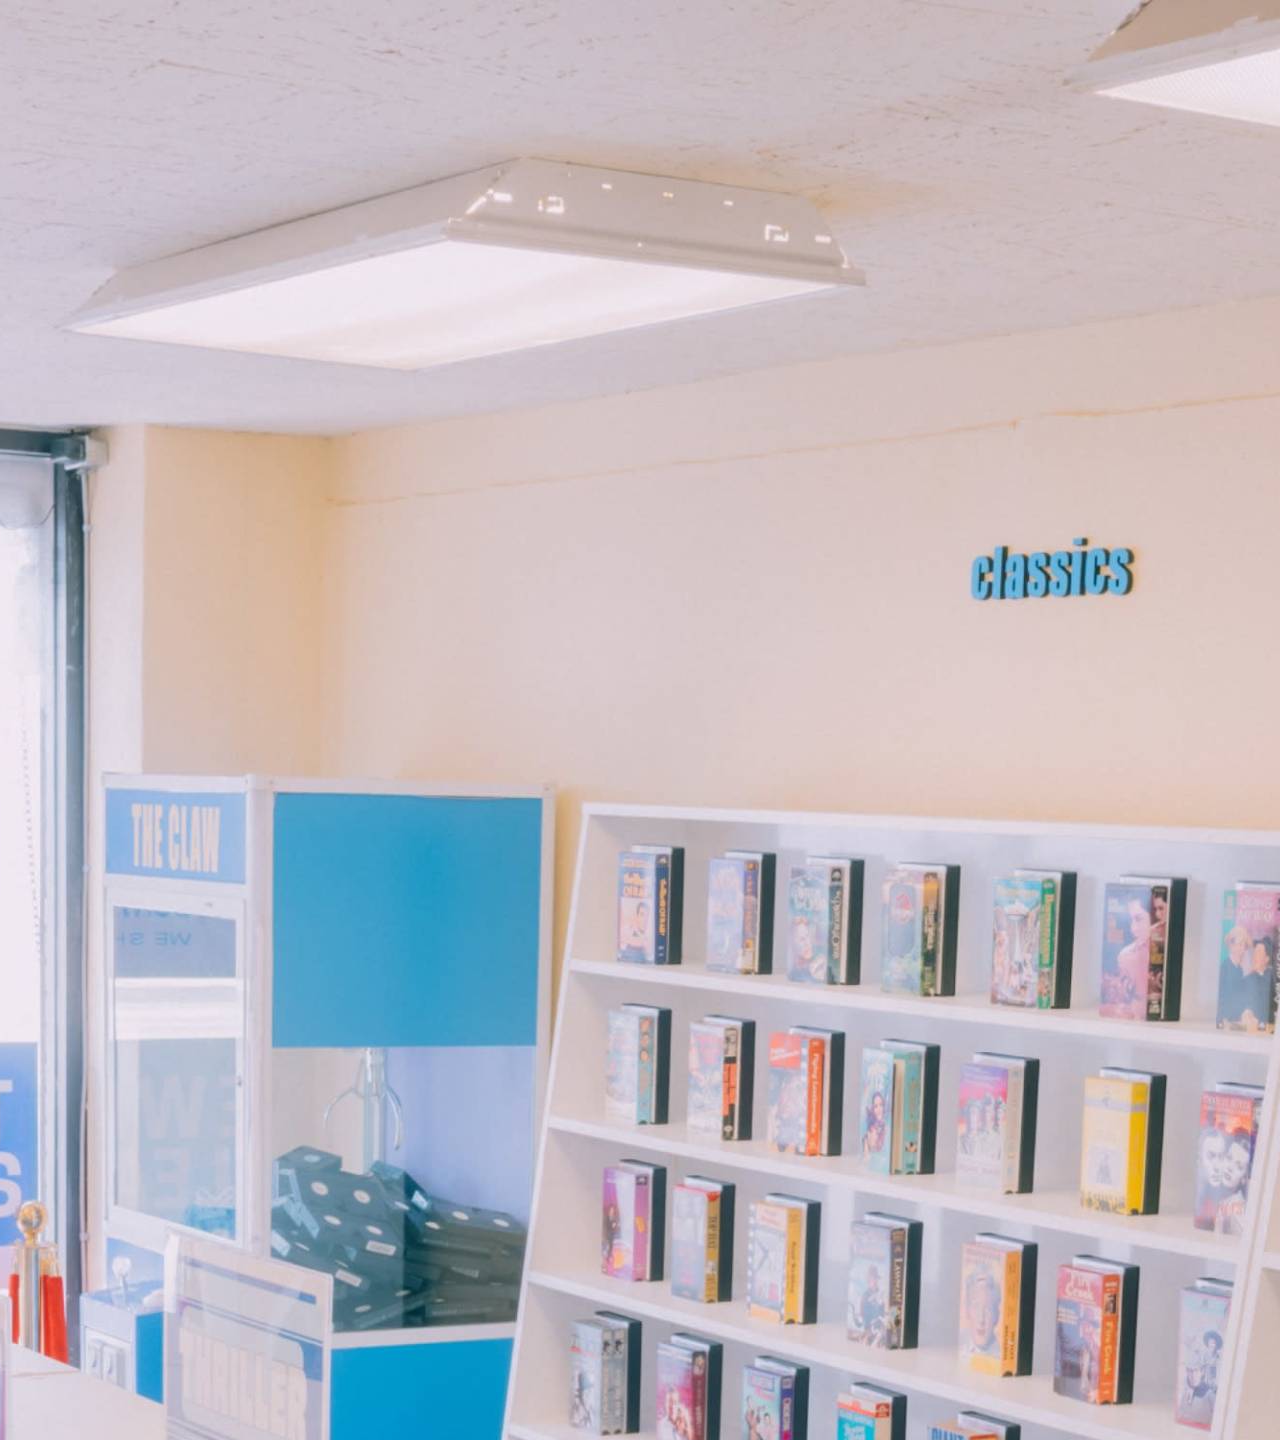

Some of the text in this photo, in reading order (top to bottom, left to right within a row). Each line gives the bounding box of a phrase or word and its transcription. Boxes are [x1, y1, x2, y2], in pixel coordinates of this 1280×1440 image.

[971, 537, 1134, 601] classics
[132, 803, 222, 873] THE CLAW
